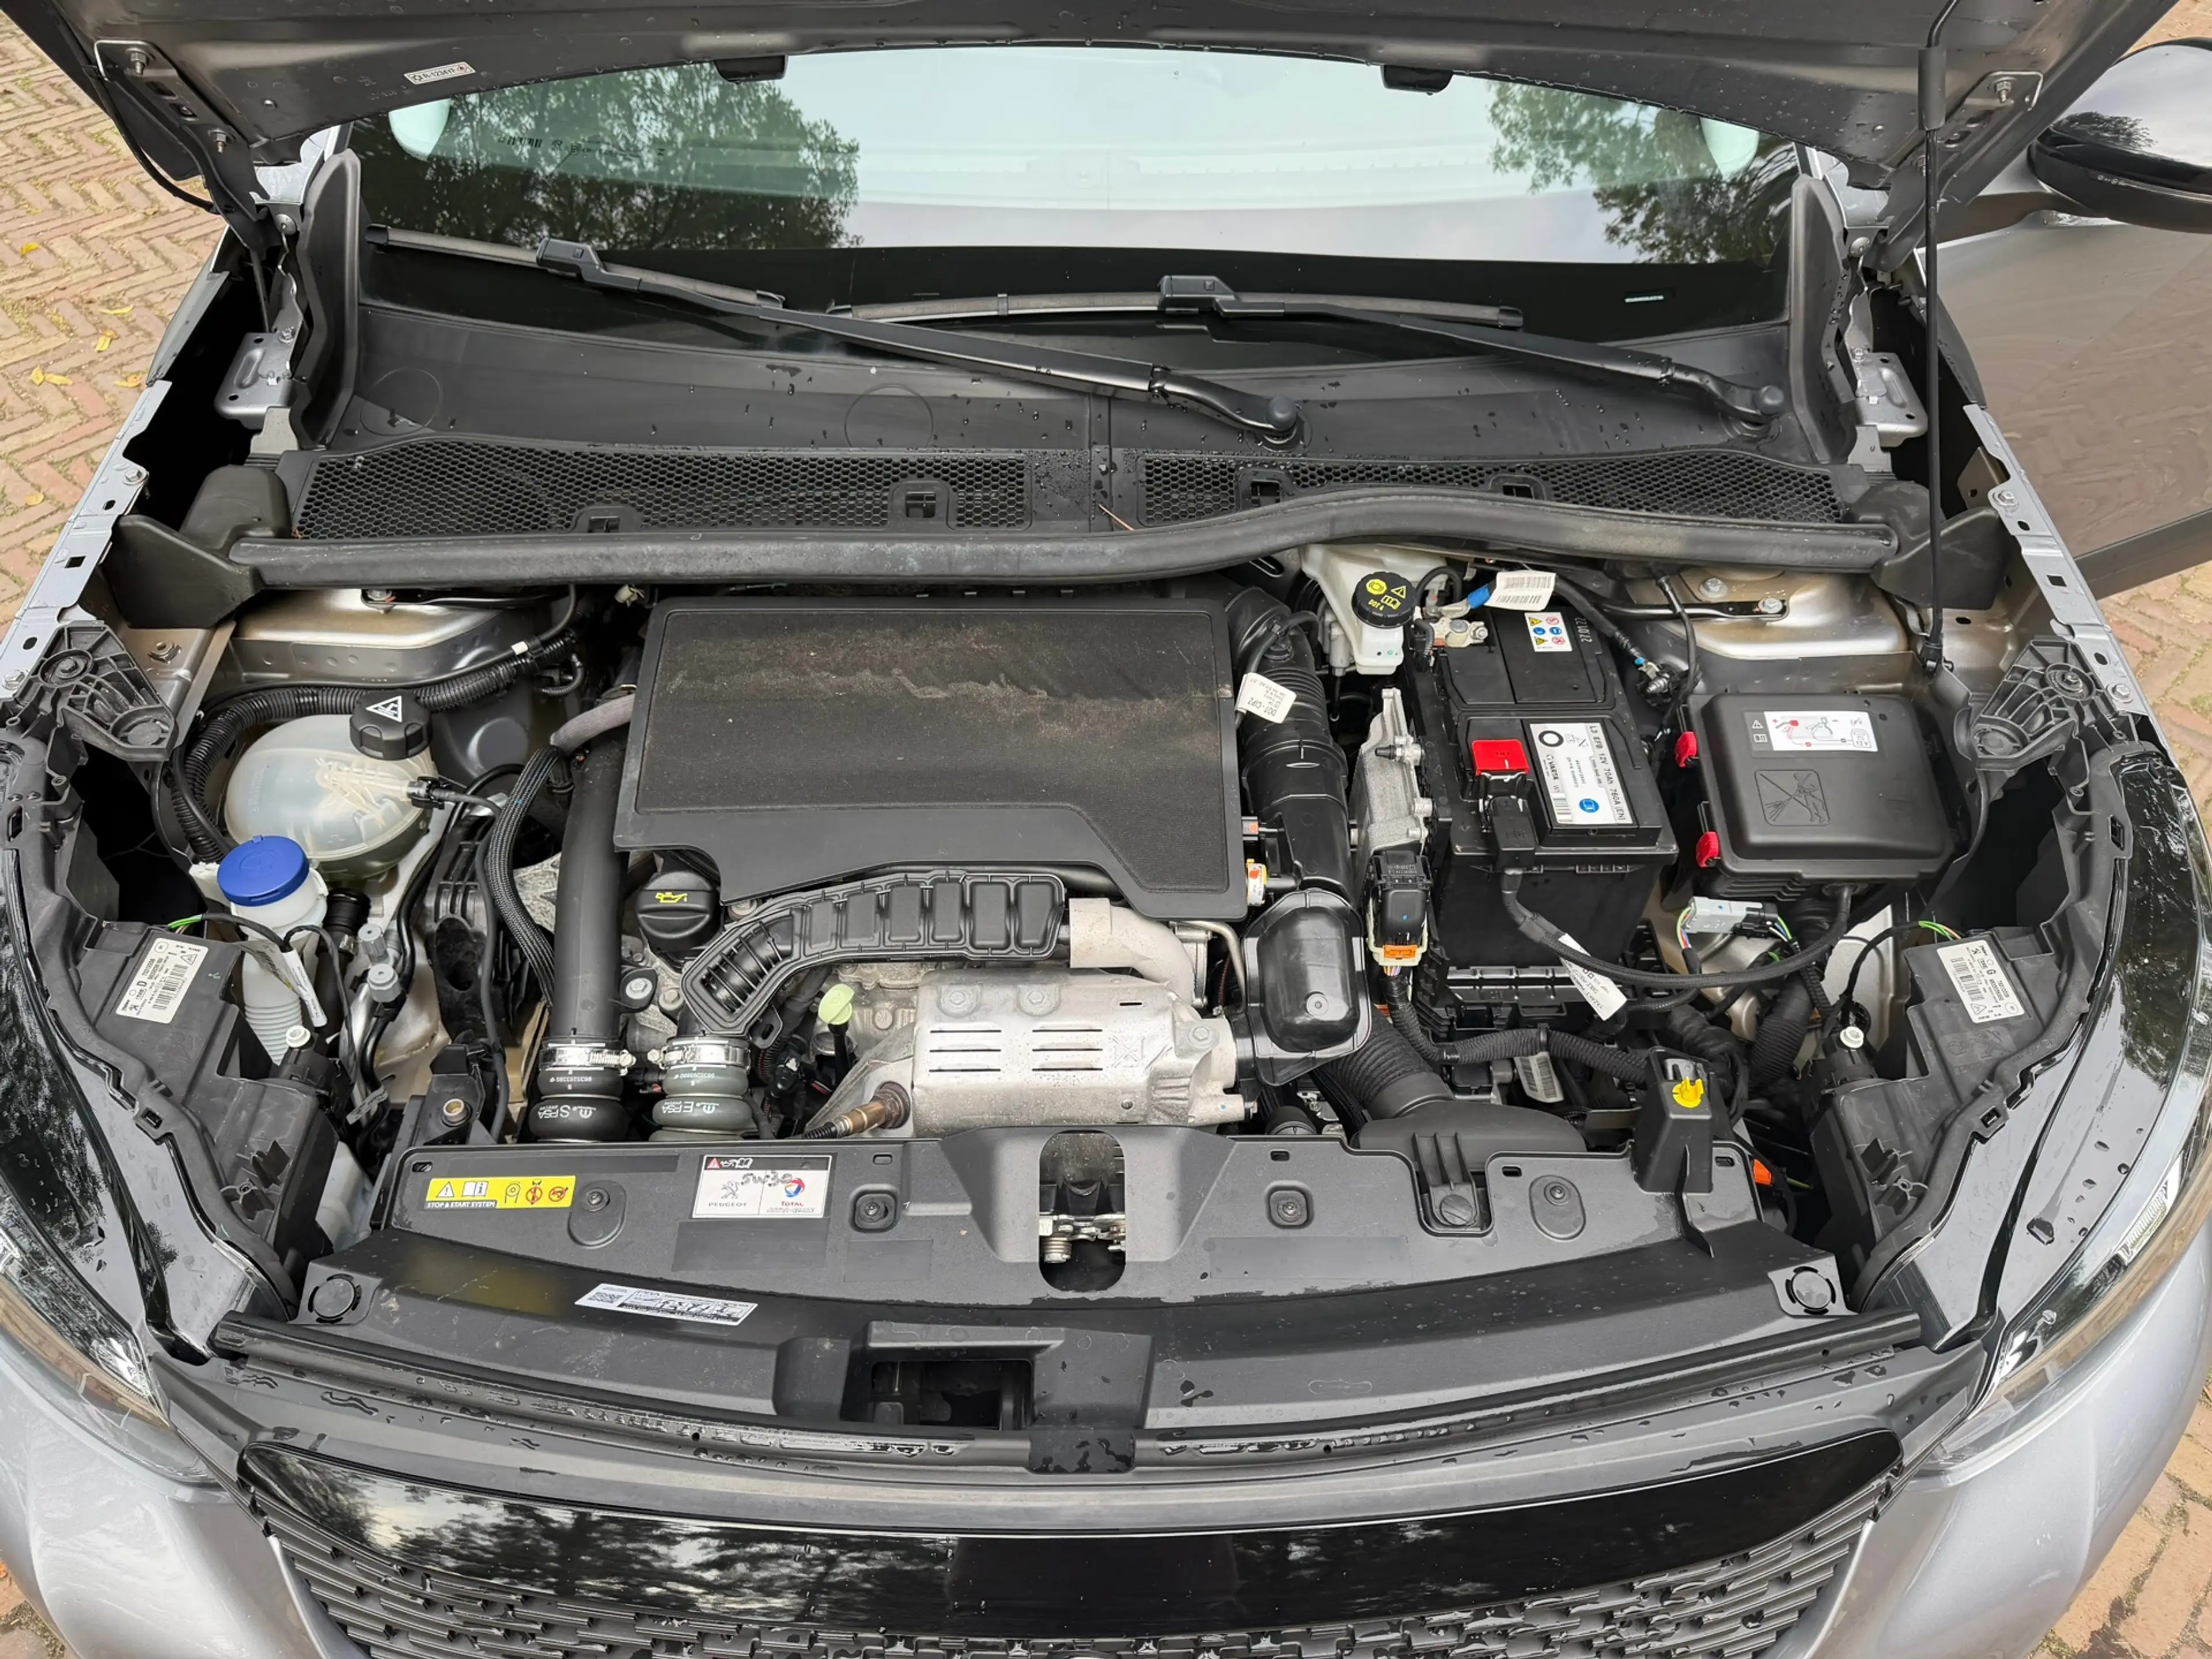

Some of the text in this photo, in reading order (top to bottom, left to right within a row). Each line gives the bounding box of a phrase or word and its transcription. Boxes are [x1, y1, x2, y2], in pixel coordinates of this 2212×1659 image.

[1548, 760, 1559, 781] VARTA
[1593, 737, 1603, 749] EFB
[1599, 753, 1608, 765] 12V
[1604, 768, 1613, 785] 70Ah
